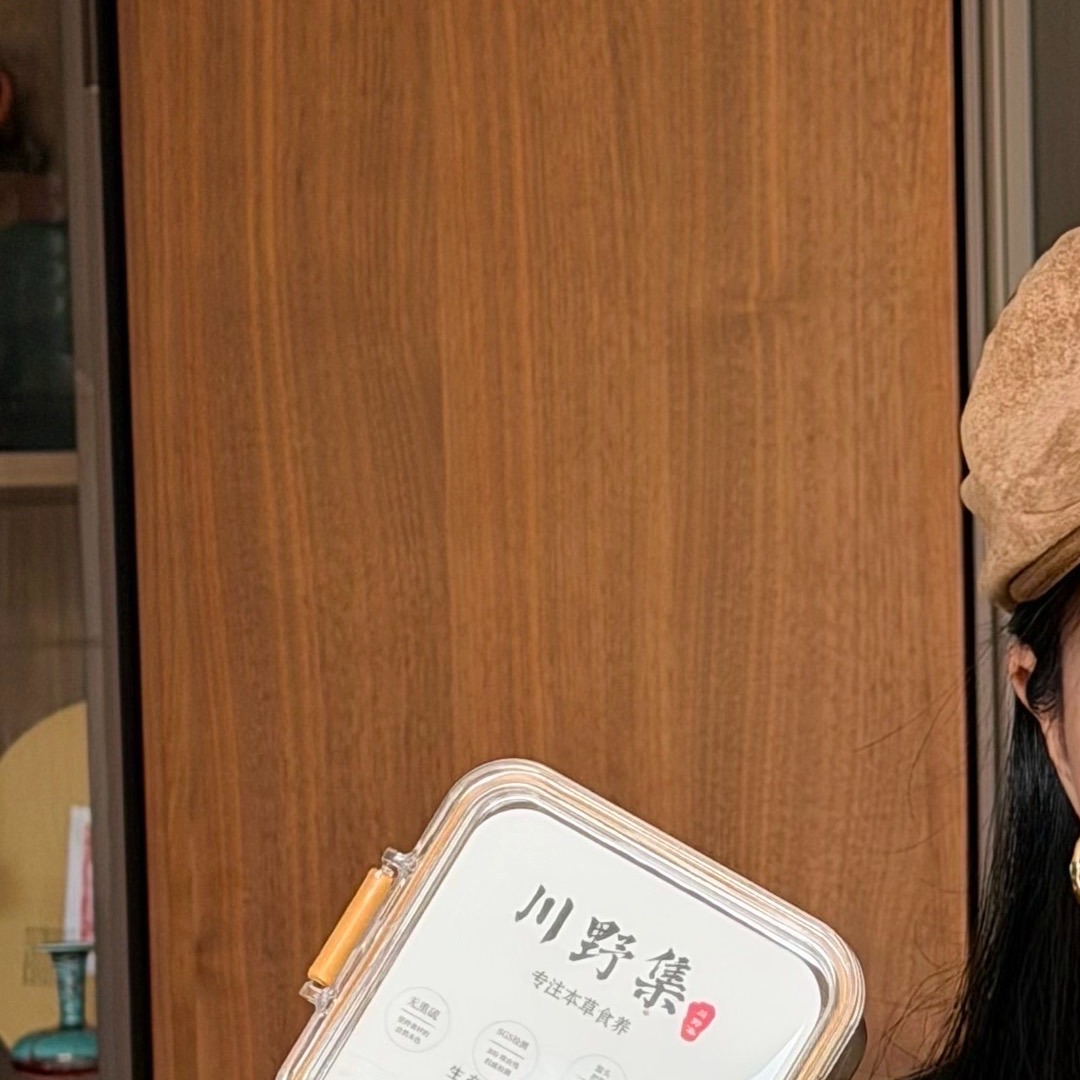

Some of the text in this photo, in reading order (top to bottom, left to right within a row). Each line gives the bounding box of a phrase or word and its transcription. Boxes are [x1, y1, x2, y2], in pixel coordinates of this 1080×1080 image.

[515, 884, 691, 1015] 川野集
[532, 970, 632, 1036] 专注本草食养
